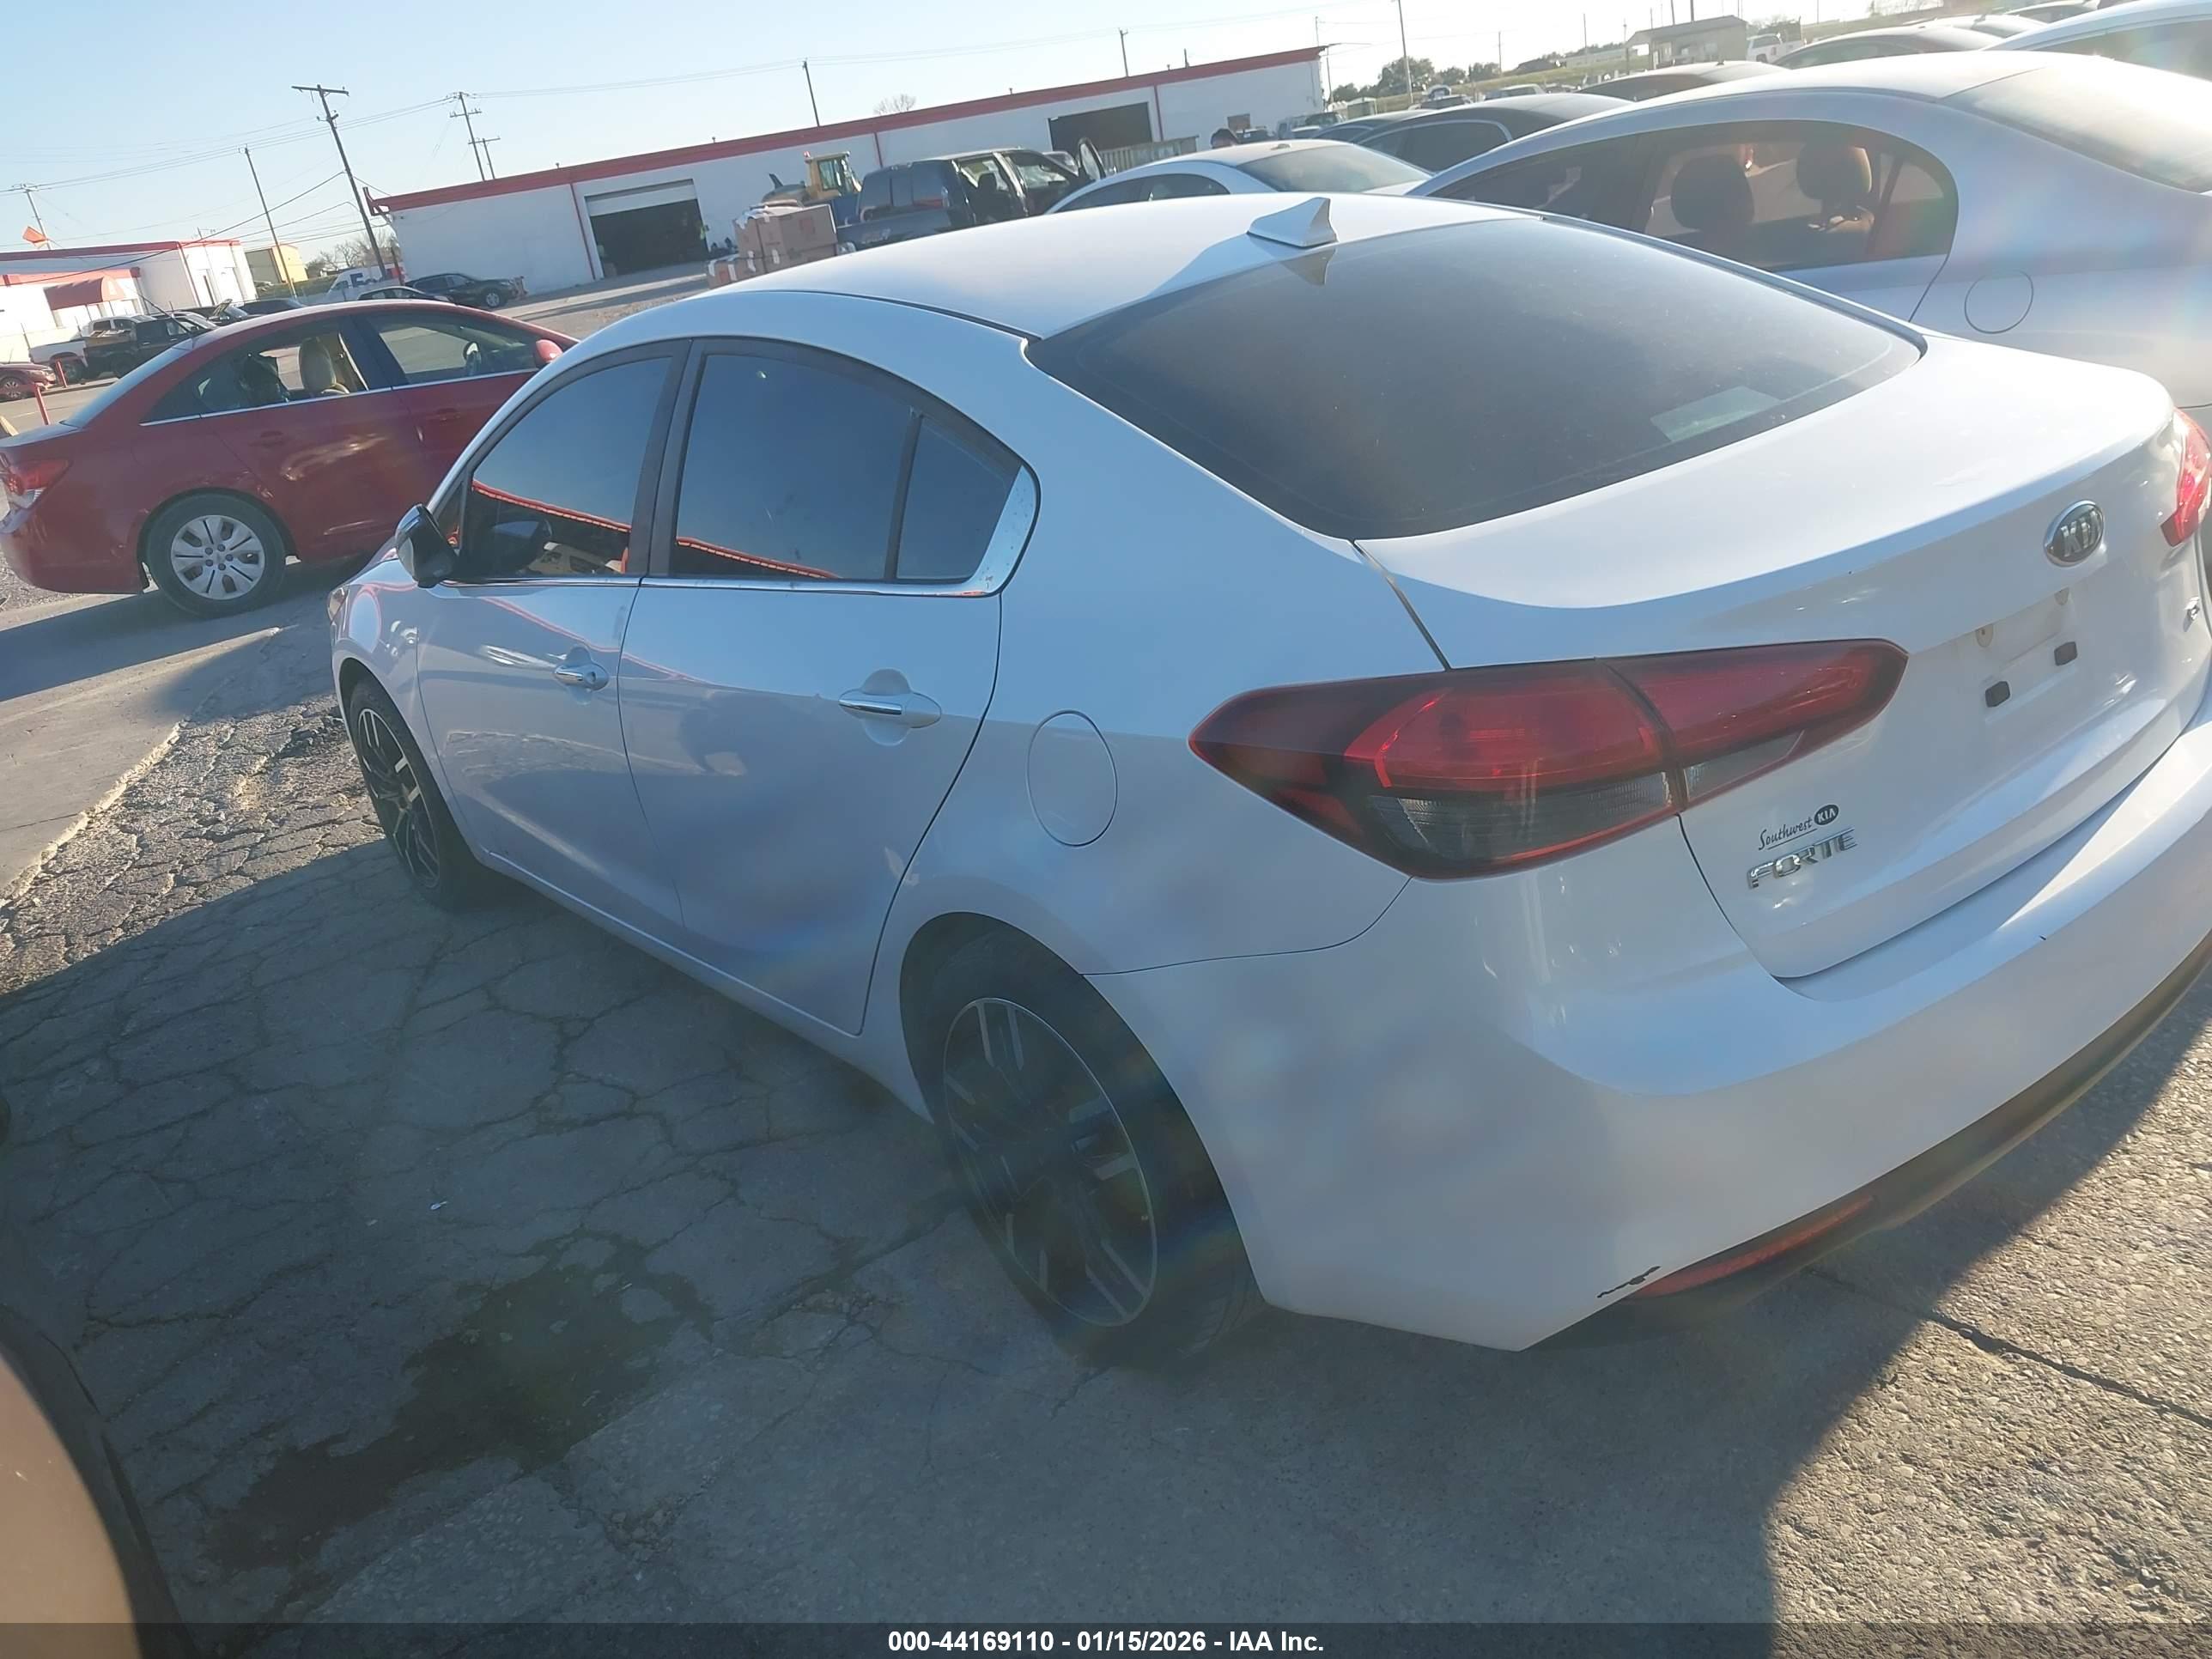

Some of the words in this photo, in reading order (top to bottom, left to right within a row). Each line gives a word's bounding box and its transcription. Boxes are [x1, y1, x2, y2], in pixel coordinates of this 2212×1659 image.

[2060, 509, 2100, 557] KIA
[1758, 817, 1813, 850] Southwest
[1816, 806, 1838, 824] KIA
[1747, 827, 1858, 890] FORTE
